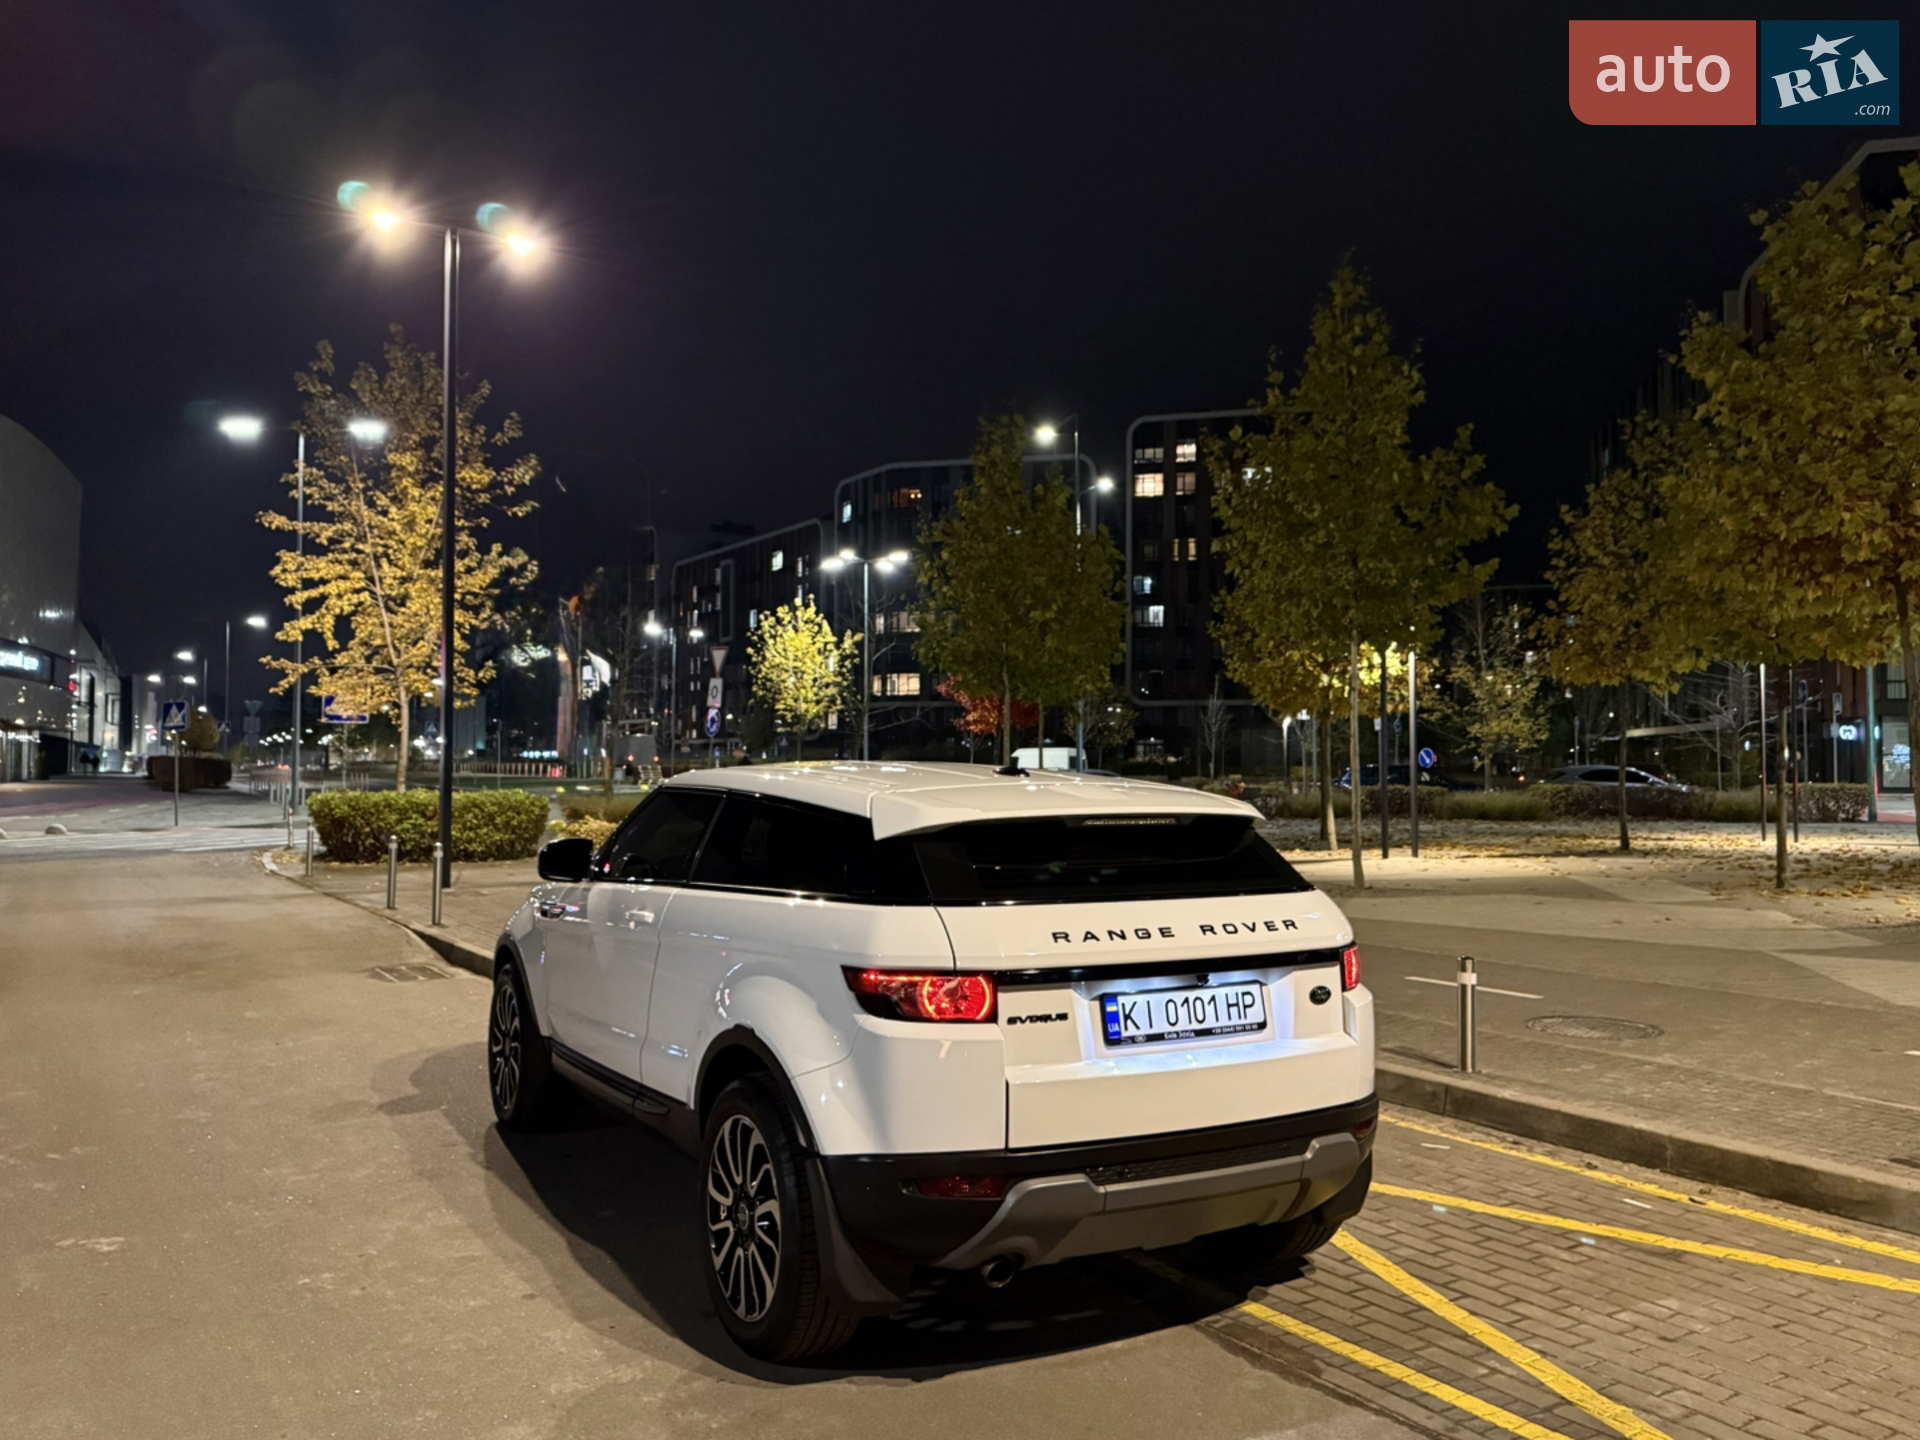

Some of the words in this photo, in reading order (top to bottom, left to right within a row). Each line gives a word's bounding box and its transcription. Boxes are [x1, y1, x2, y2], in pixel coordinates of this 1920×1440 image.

[1051, 926, 1175, 944] RANGE
[1199, 919, 1299, 936] ROVER
[1006, 1012, 1069, 1026] EVOQUE
[1121, 1000, 1154, 1031] KI
[1164, 993, 1219, 1027] 0101
[1225, 990, 1256, 1021] HP
[1107, 1022, 1121, 1033] UA
